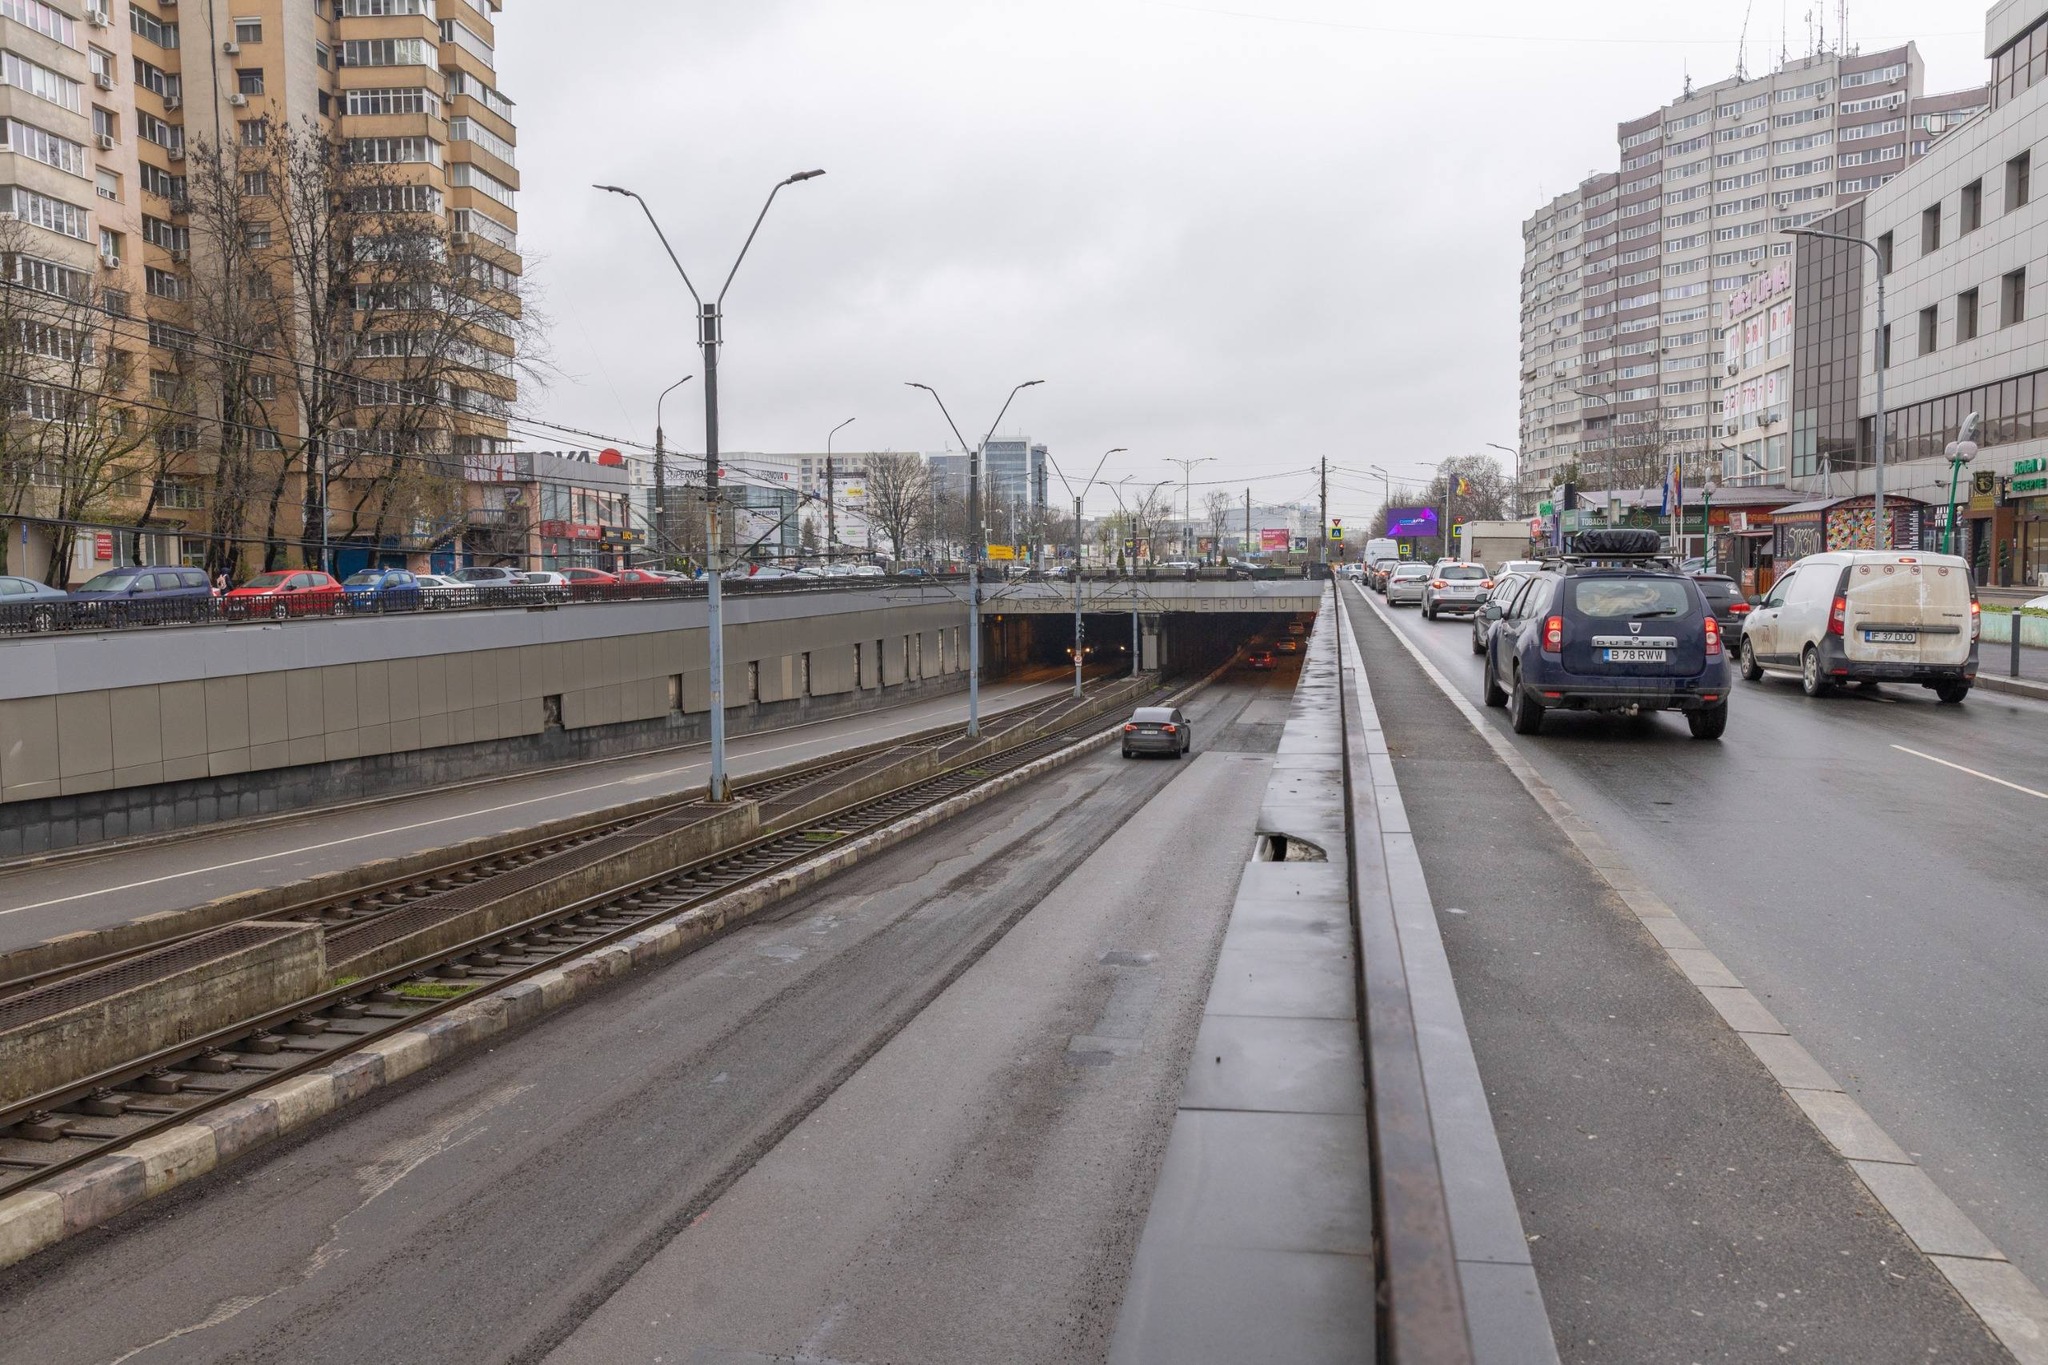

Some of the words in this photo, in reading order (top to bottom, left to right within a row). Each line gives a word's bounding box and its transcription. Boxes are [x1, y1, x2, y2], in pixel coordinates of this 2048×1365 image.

[2014, 459, 2034, 475] Hotel
[1686, 515, 1702, 524] SHOP
[1871, 632, 1879, 640] IF
[1882, 632, 1892, 640] 37
[1895, 633, 1914, 641] DUO
[1611, 650, 1619, 660] B
[1622, 650, 1636, 660] 78
[1638, 650, 1663, 660] RWW
